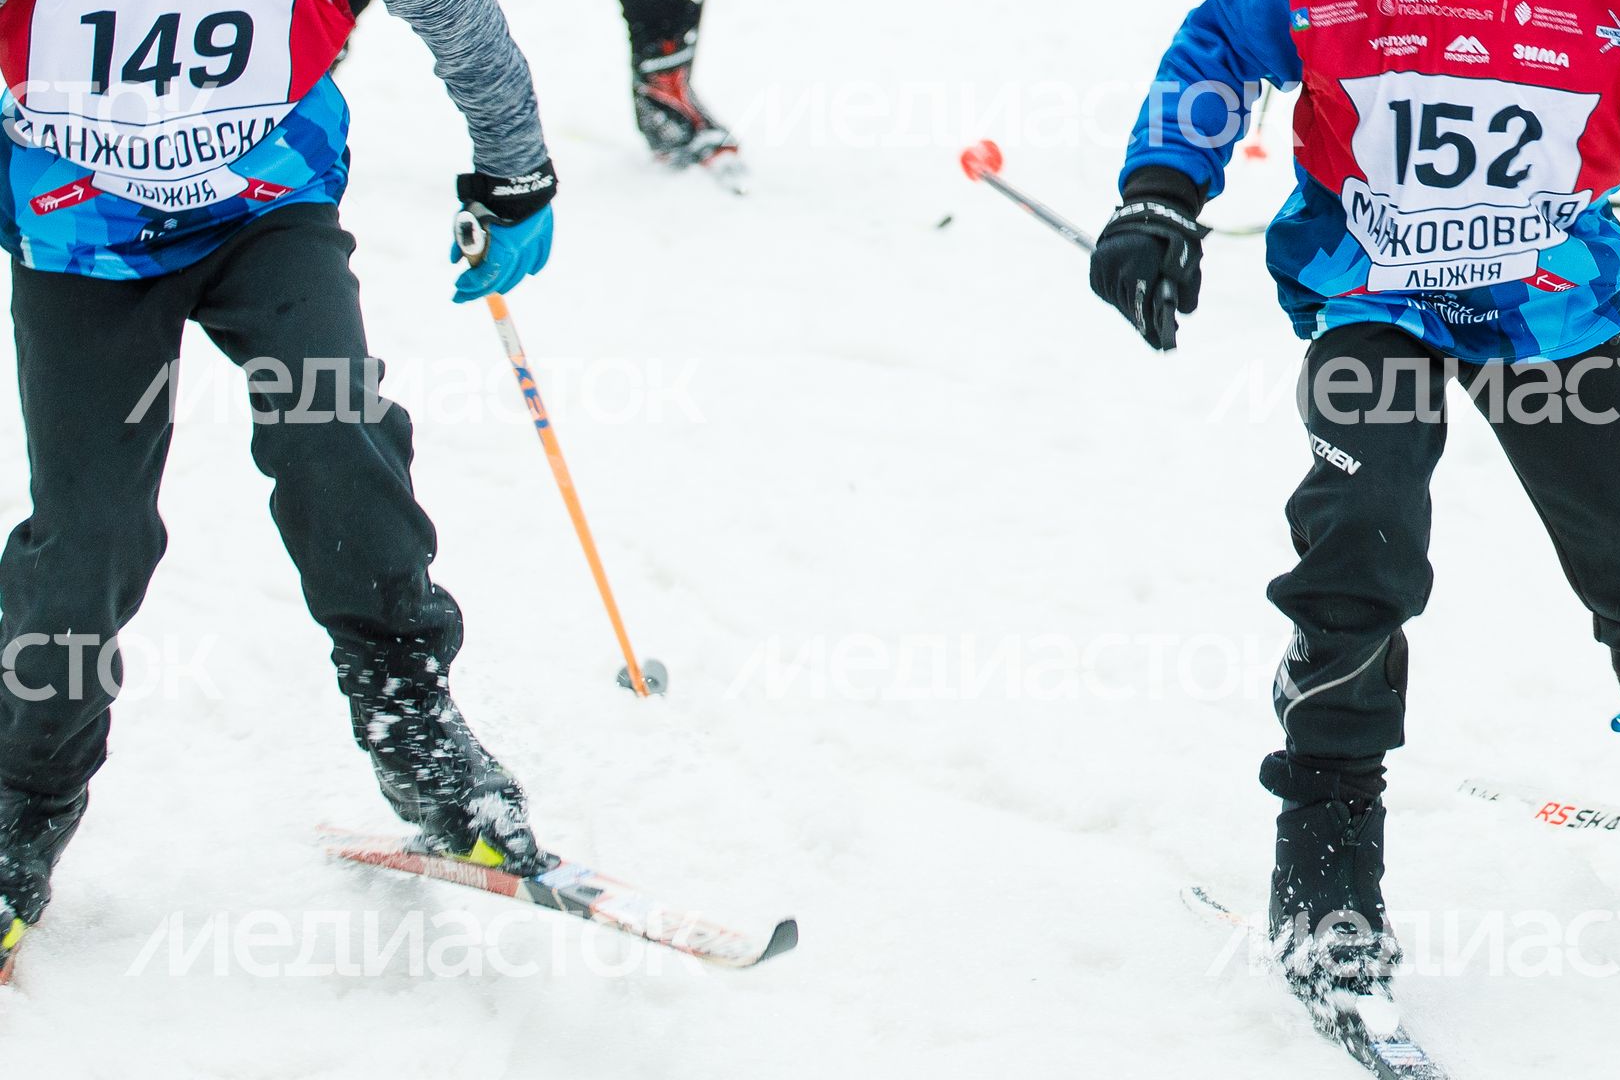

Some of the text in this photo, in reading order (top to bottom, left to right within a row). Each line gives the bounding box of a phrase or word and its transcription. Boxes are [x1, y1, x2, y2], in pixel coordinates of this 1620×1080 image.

[81, 10, 254, 97] 149
[1513, 43, 1569, 68] ЗИМА
[1389, 99, 1542, 189] 152
[126, 179, 217, 207] ЛЫЖНЯ
[1406, 263, 1502, 288] ЛЫЖНЯ
[1309, 432, 1362, 476] TZHEN
